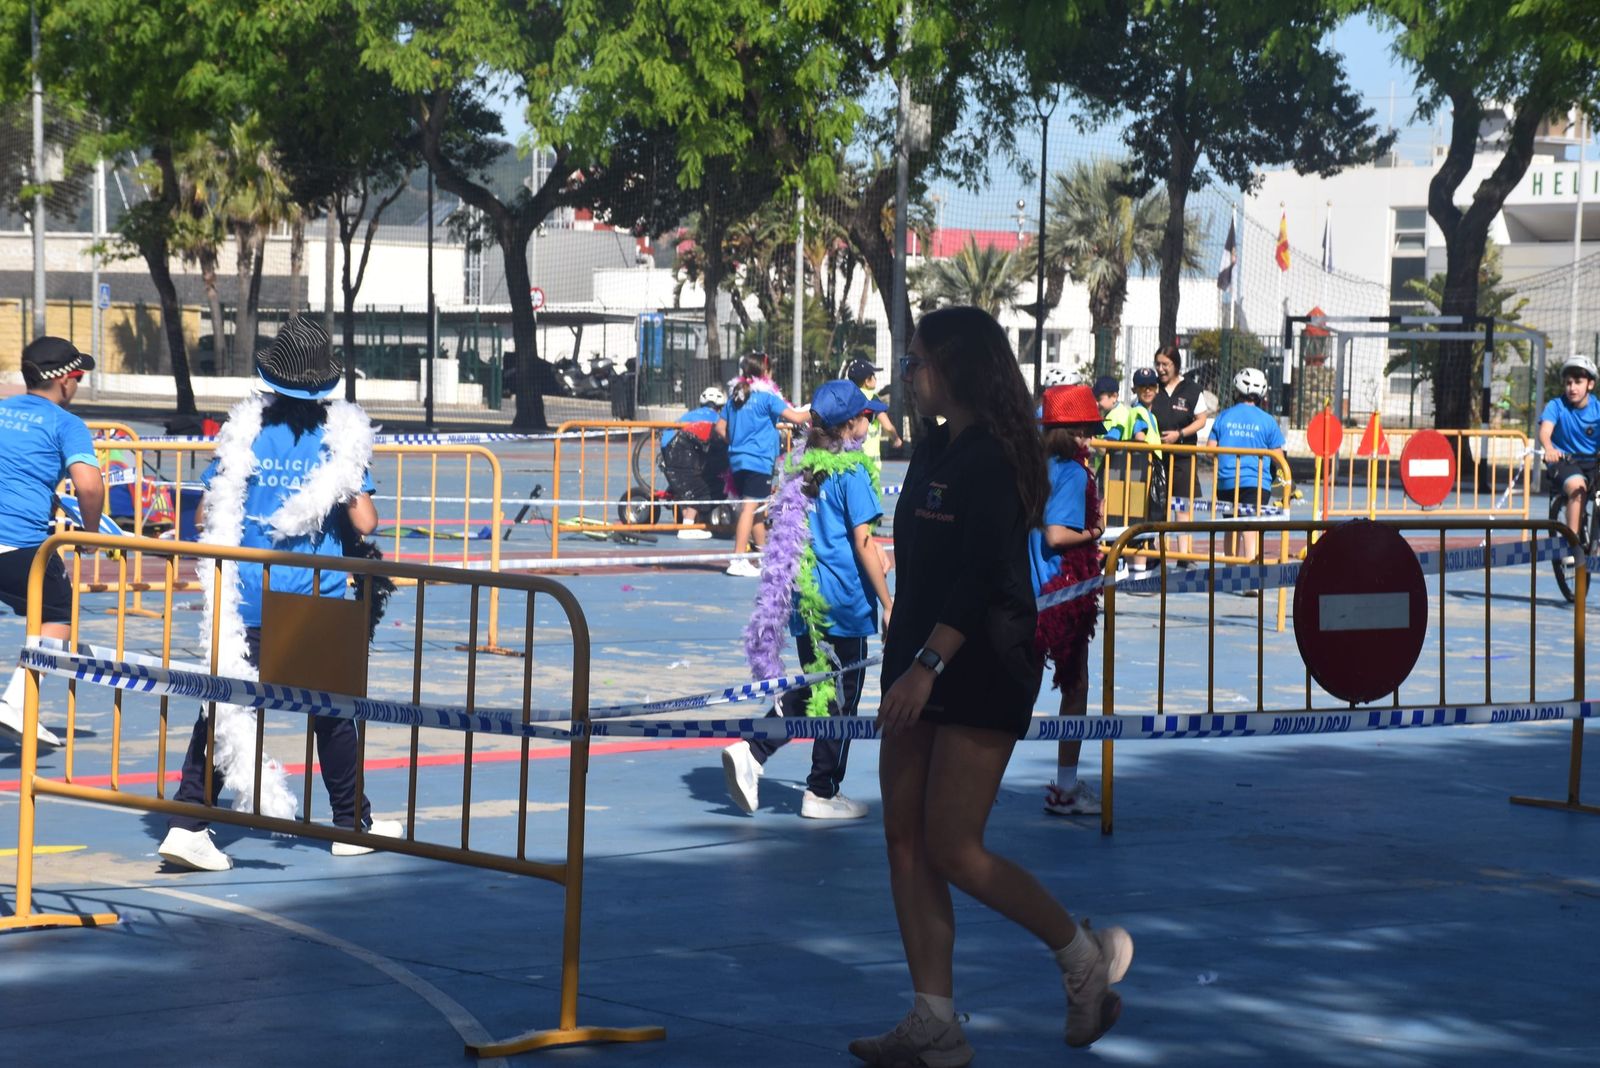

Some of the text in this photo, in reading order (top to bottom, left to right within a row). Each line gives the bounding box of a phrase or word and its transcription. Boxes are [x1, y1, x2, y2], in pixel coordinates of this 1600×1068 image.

[1229, 429, 1255, 438] LOCAL
[165, 670, 204, 698] POLICIA
[352, 700, 392, 721] POLICIA
[785, 719, 836, 740] POLICIA
[1036, 719, 1085, 740] POLICIA
[1271, 716, 1316, 735] POLICIA
